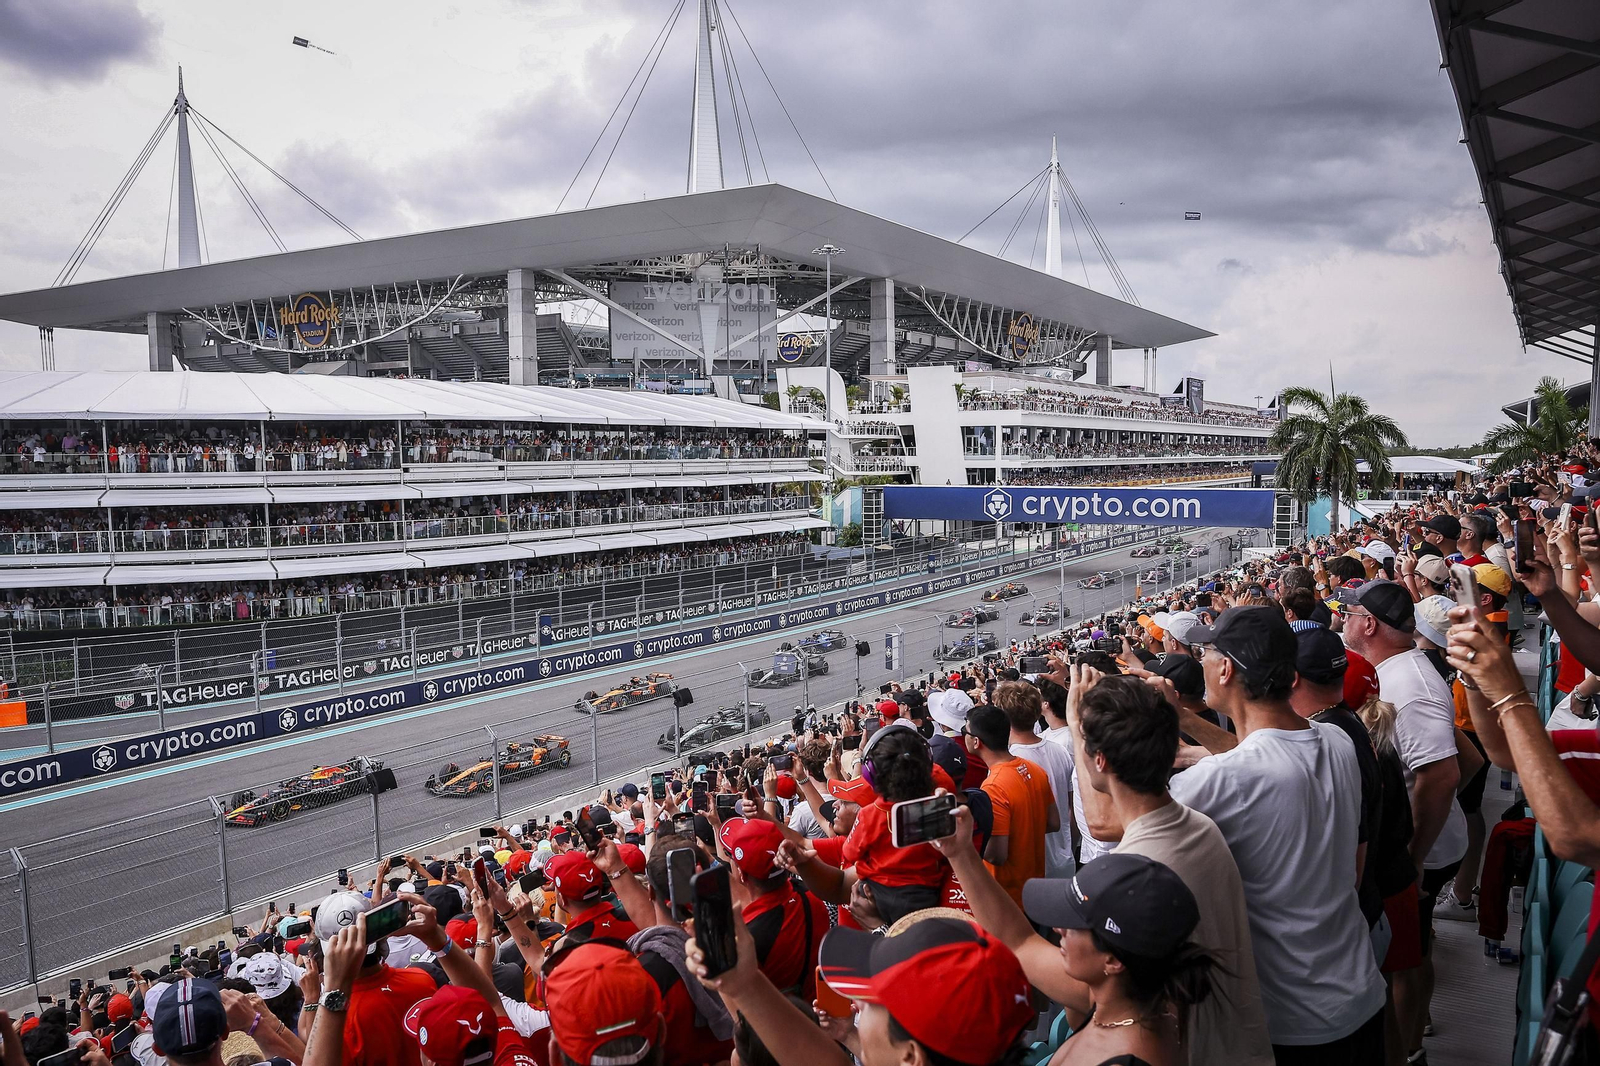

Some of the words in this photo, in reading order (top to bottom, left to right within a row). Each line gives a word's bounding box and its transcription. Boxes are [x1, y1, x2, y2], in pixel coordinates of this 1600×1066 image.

[619, 301, 654, 310] erizon
[674, 302, 698, 310] veriz
[732, 303, 770, 312] verizon
[279, 305, 308, 325] Hard
[310, 302, 339, 326] Rock
[717, 317, 742, 326] rizon
[615, 332, 655, 340] verizon
[674, 332, 700, 341] veriz
[645, 347, 684, 356] verizon
[1022, 492, 1201, 520] crypto.com
[934, 577, 961, 590] crypto.com
[892, 586, 923, 600] crypto.com
[844, 596, 880, 611] crypto.com
[789, 607, 829, 624] crypto.com
[724, 620, 770, 637] crypto.com
[647, 632, 702, 653] crypto.com
[555, 648, 622, 671] crypto.com
[443, 666, 525, 694] crypto.com
[304, 690, 405, 722] crypto.com
[126, 721, 256, 760] crypto.com
